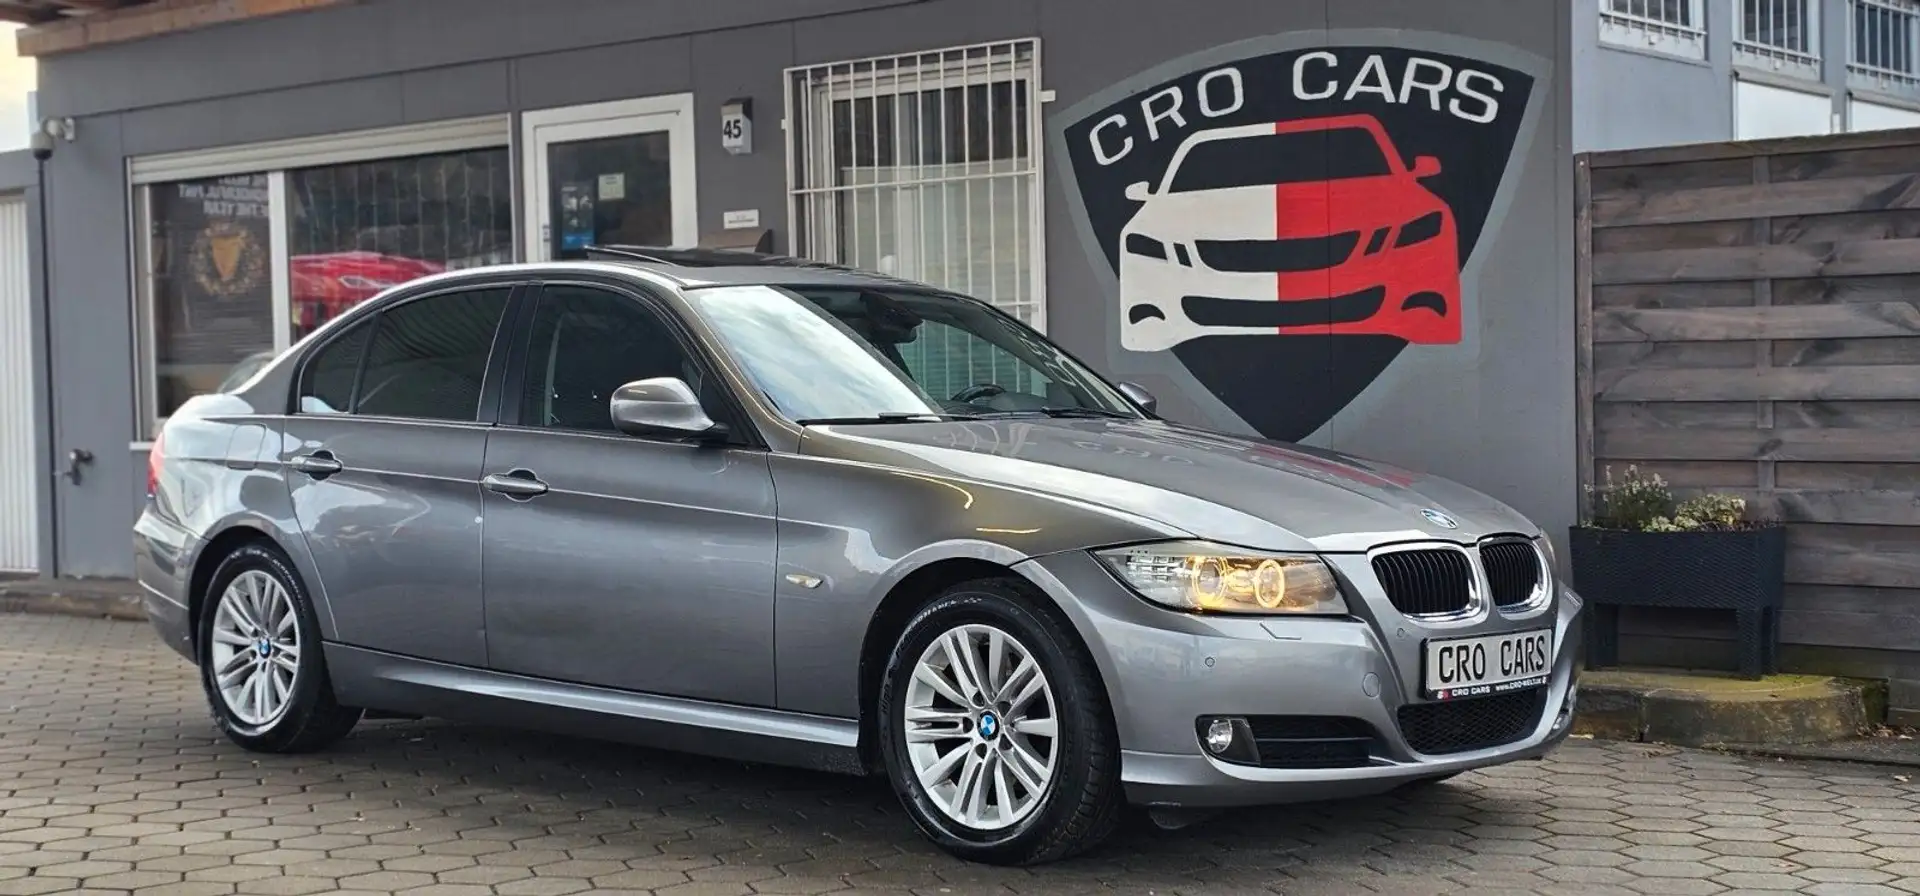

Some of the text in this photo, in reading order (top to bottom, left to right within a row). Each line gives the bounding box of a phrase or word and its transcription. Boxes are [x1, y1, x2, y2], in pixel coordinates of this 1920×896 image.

[1089, 51, 1504, 166] CRO CARS
[723, 119, 742, 139] 45
[1439, 635, 1545, 684] CRO CARS
[1451, 688, 1469, 697] CRO
[1471, 685, 1491, 695] CARS
